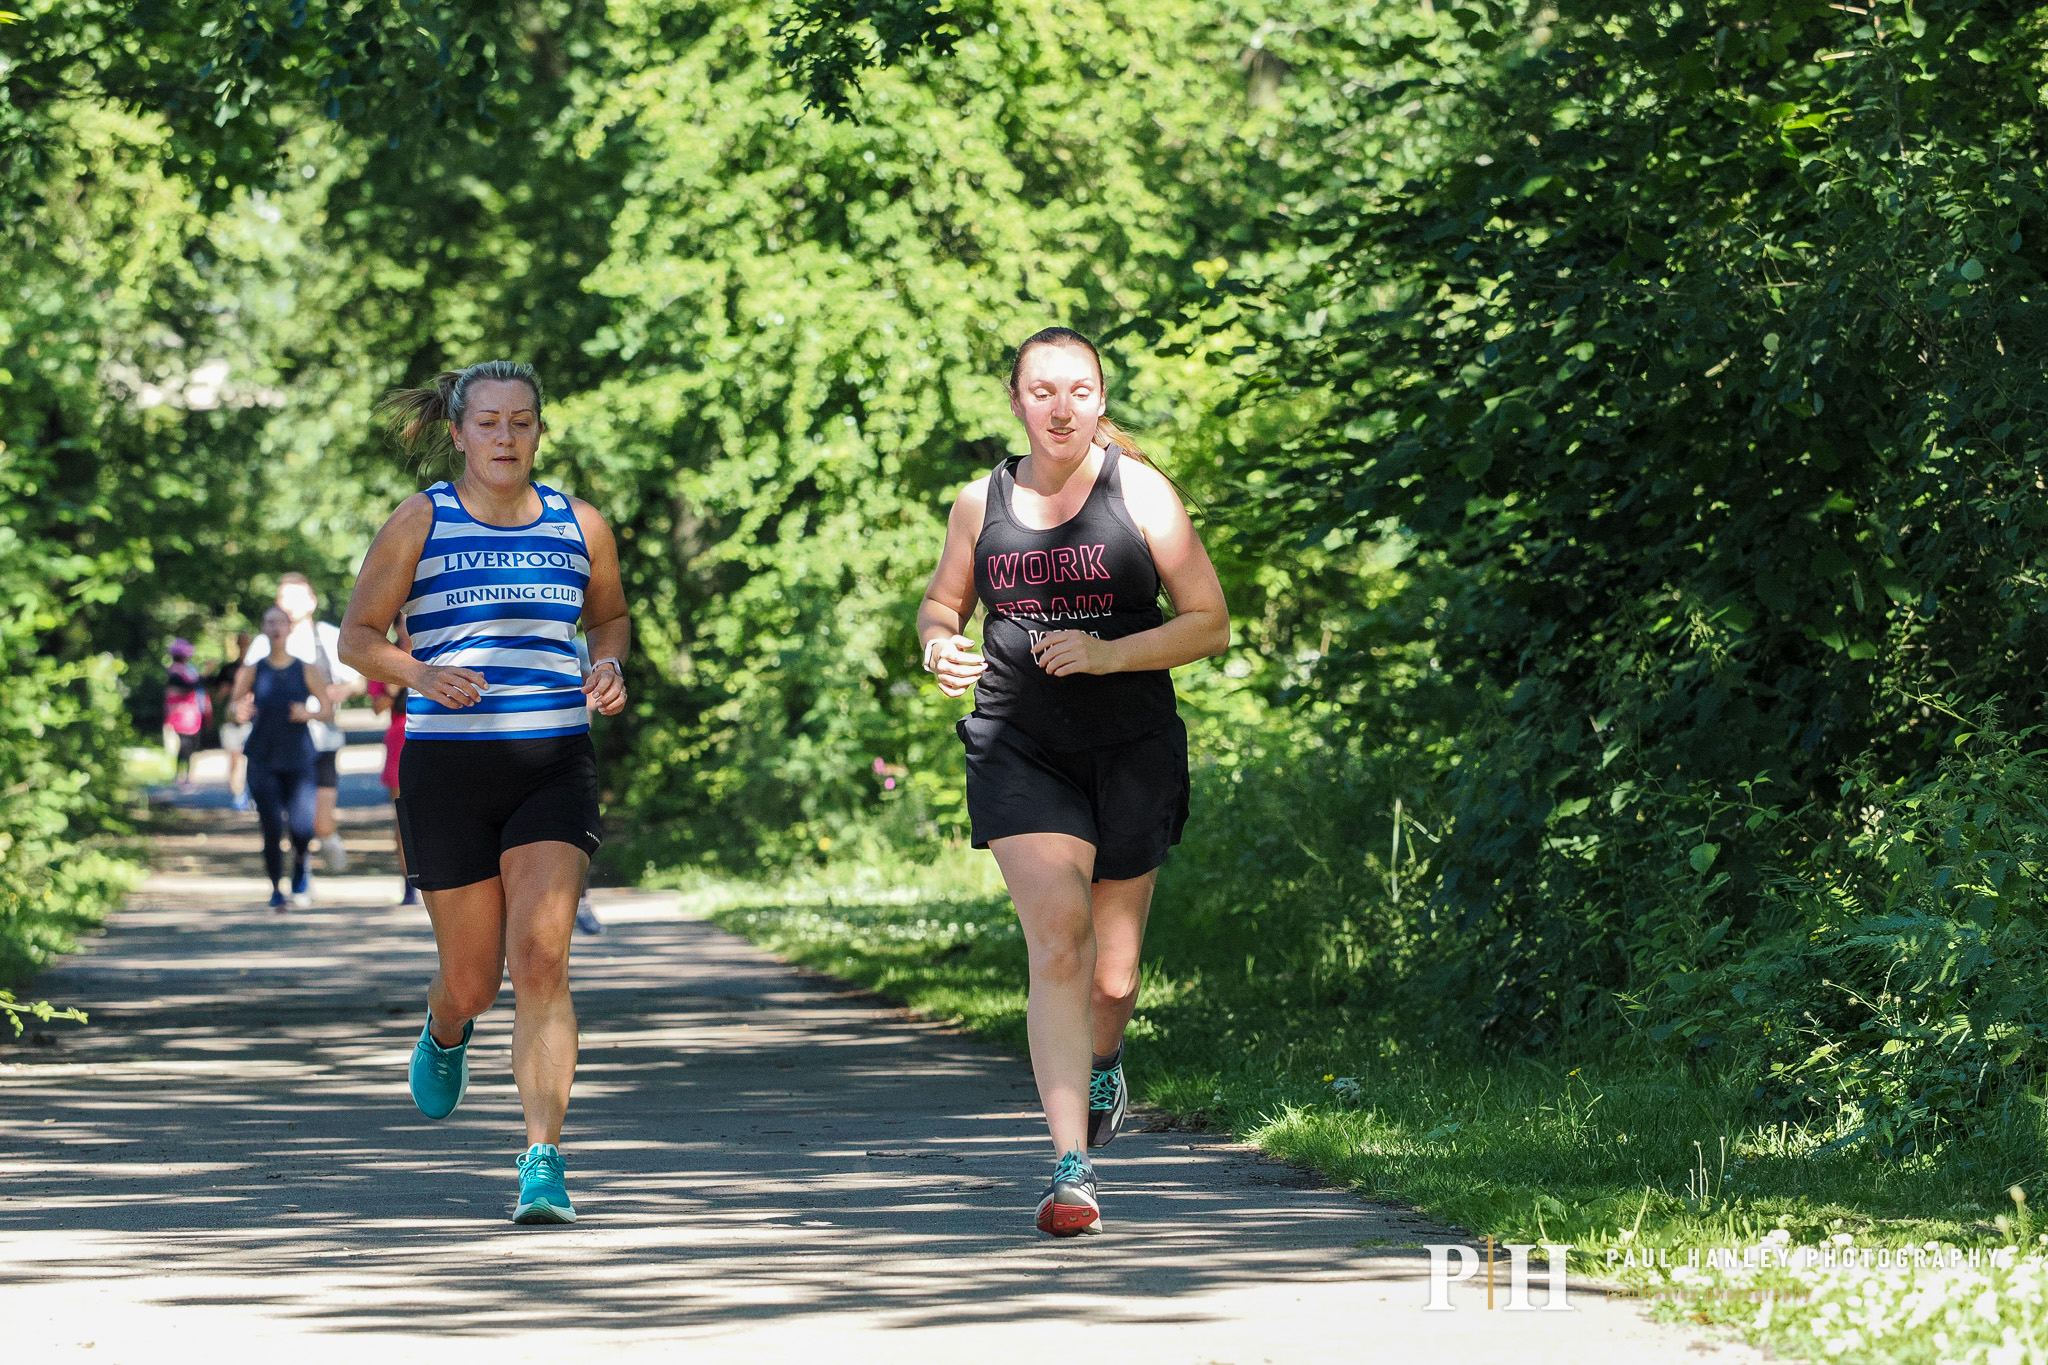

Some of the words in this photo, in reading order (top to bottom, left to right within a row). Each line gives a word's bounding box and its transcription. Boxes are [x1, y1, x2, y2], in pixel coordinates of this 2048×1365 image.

[444, 552, 576, 572] LIVERPOOL
[988, 543, 1111, 590] WORK
[446, 587, 536, 606] RUNNING
[541, 586, 577, 602] CLUB
[995, 593, 1114, 622] TRAIN
